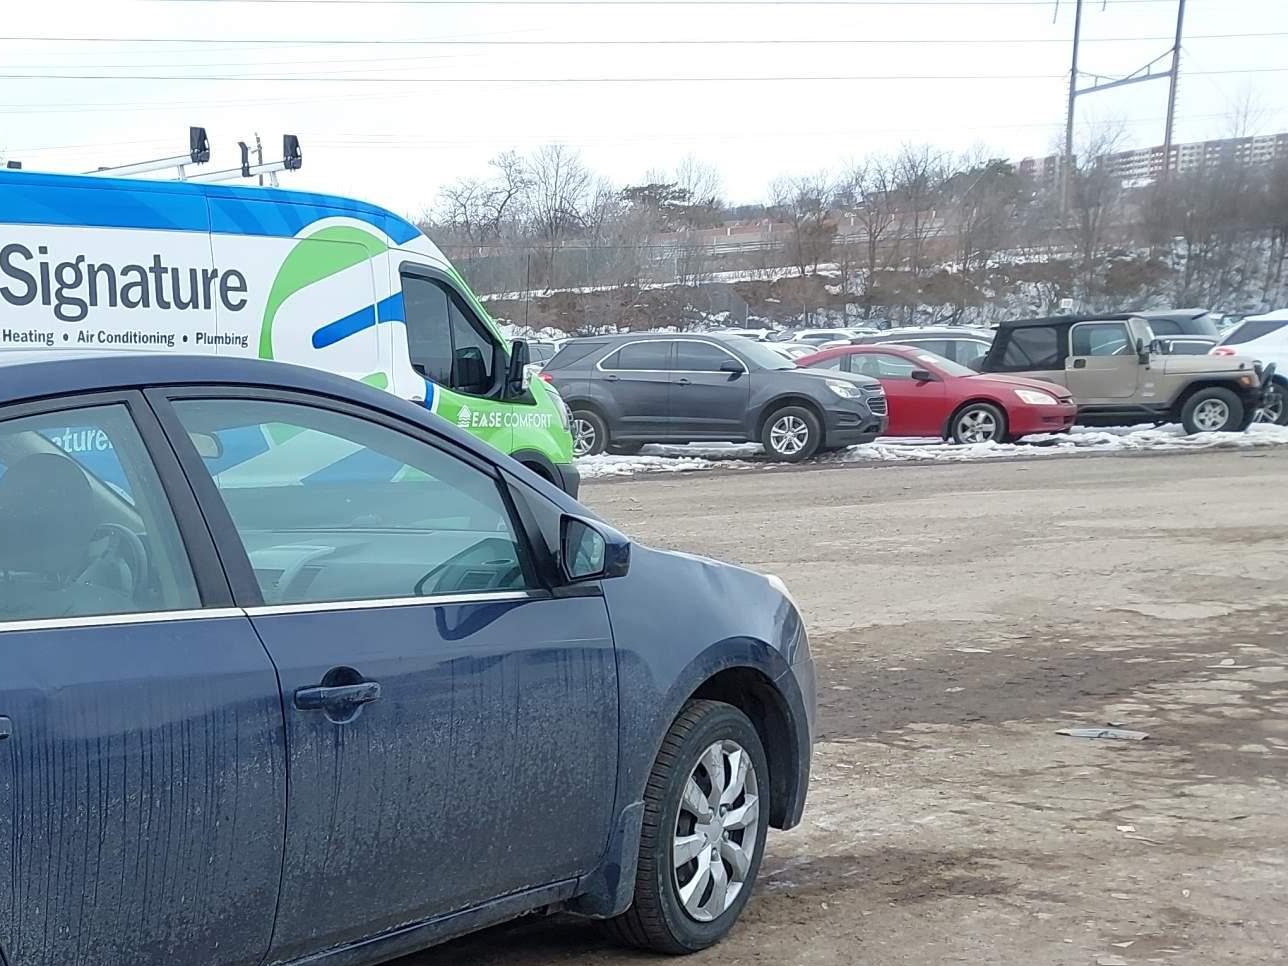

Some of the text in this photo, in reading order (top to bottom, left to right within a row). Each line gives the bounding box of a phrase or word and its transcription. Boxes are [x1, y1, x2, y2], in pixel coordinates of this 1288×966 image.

[0, 243, 249, 322] Signature
[2, 329, 249, 348] Heating Air Conditioning Plumbing
[472, 411, 553, 428] EASE COMFORT
